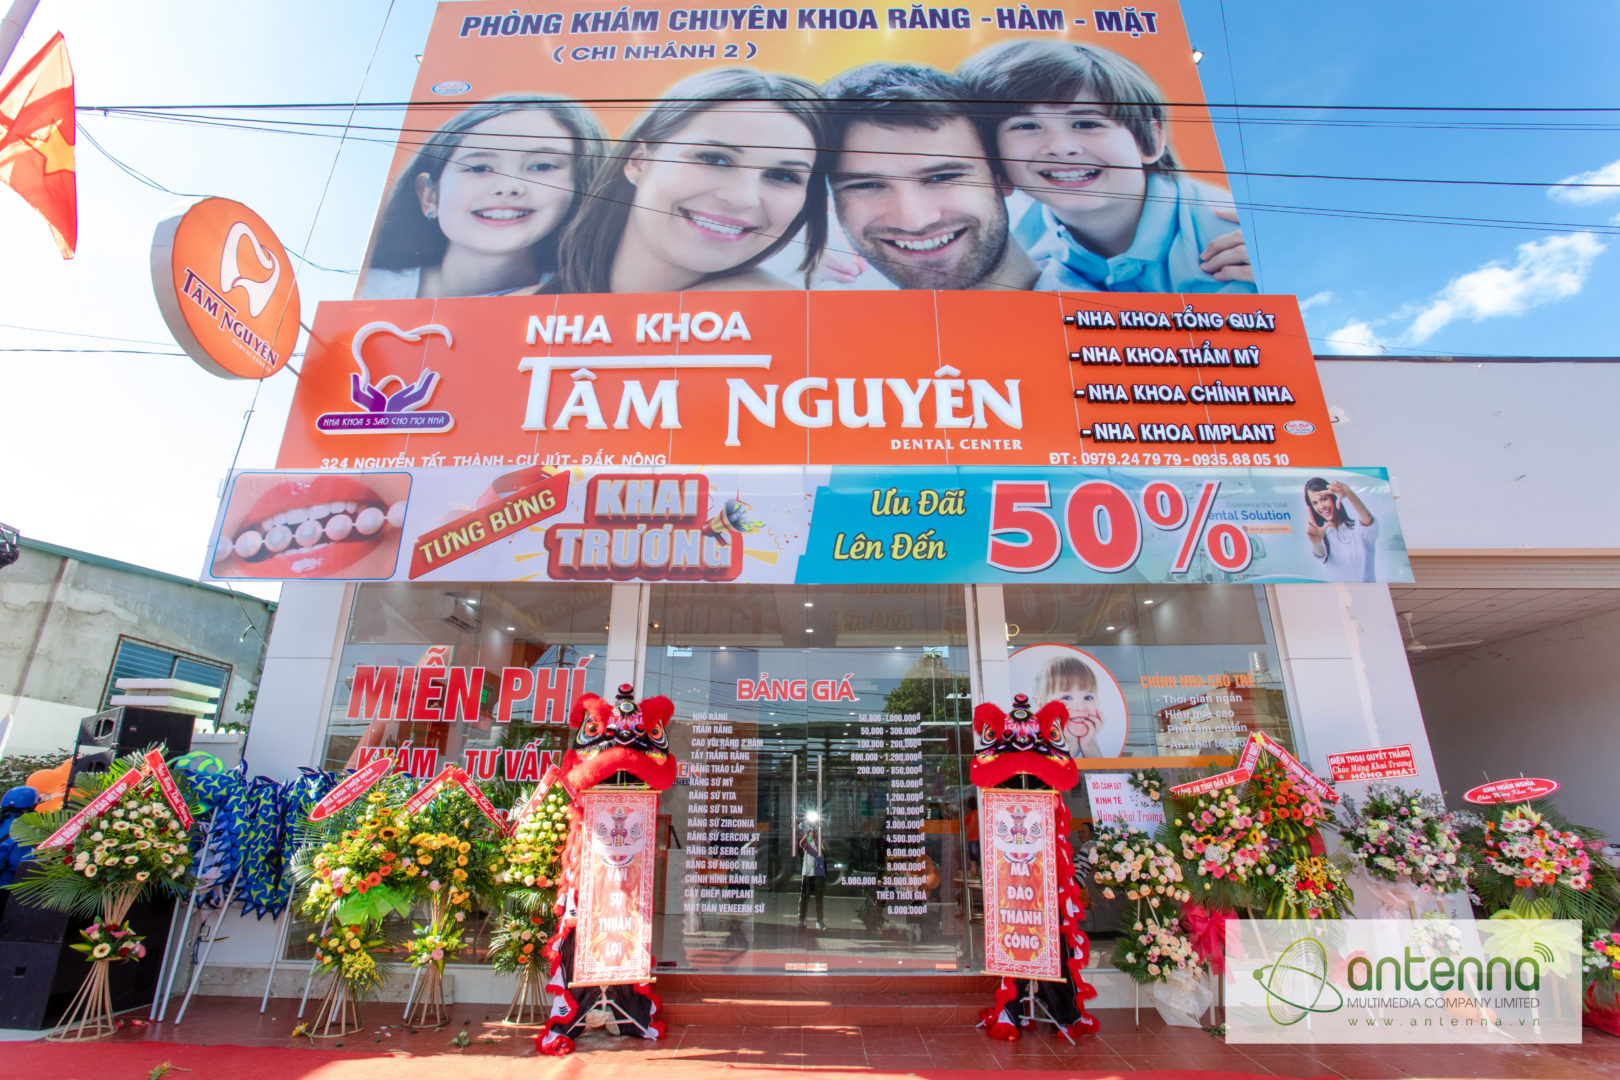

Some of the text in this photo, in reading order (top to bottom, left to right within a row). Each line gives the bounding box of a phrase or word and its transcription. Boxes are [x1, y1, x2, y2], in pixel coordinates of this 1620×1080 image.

[460, 10, 563, 37] PHÒNG
[571, 7, 660, 34] KHÁM
[668, 5, 787, 32] CHUYÊN
[798, 8, 878, 30] KHOA
[887, 4, 971, 31] RĂNG
[1093, 6, 1158, 38] MẶT
[624, 41, 715, 60] NHÁNH
[181, 267, 279, 368] TÂM NGUYÊN
[1119, 311, 1172, 330] KHOA
[1173, 304, 1224, 331] TỔNG
[1227, 309, 1276, 331] QUÁT
[525, 311, 752, 345] NHA KHOA
[1125, 347, 1179, 366] KHOA
[1180, 340, 1231, 367] THẨM
[1233, 345, 1260, 367] MỸ
[517, 354, 1023, 447] TÂM NGUYÊN
[1131, 384, 1188, 404] KHOA
[1189, 380, 1250, 405] CHỈNH
[1253, 386, 1295, 404] NHA
[428, 416, 445, 424] NHÀ
[1140, 424, 1195, 443] KHOA
[1197, 424, 1276, 443] IMPLANT
[891, 439, 1023, 450] DENTAL CENTER
[320, 458, 348, 469] 324
[354, 452, 415, 468] NGUYỄN
[421, 452, 446, 468] TẤT
[453, 453, 503, 465] THÀNH
[516, 453, 539, 465] CƯ
[582, 449, 615, 465] ĐẮK
[622, 452, 666, 465] NÔNG
[1081, 453, 1140, 465] 0979.24
[1143, 453, 1161, 465] 79
[1164, 453, 1182, 465] 79
[1193, 453, 1251, 466] 0935.88
[1253, 454, 1271, 466] 05
[1274, 454, 1289, 466] 10
[594, 479, 699, 517] KHAI
[871, 488, 967, 517] Ưu Đãi
[1209, 510, 1291, 520] ental Solution
[419, 489, 557, 564] TƯNG BỪNG
[987, 478, 1253, 574] 50%
[555, 524, 731, 568] TRƯƠNG
[833, 530, 946, 561] Lên Đến
[346, 647, 595, 724] MIỄN PHÍ
[737, 672, 856, 701] BẢNG GIÁ
[1140, 672, 1176, 688] CHỈNH
[1179, 675, 1205, 688] NHA
[1207, 675, 1230, 687] CHO
[1190, 695, 1212, 705] gian
[464, 747, 503, 780] TƯ
[505, 739, 561, 782] VẤN
[1333, 765, 1349, 774] Chúc
[1371, 762, 1386, 770] Khai
[690, 777, 708, 786] RĂNG
[689, 790, 708, 800] RĂNG
[722, 792, 736, 800] VITA
[1114, 794, 1122, 804] TẾ
[688, 804, 708, 813] RĂNG
[722, 805, 727, 813] TI
[730, 805, 743, 813] TAN
[688, 817, 707, 827] RĂNG
[721, 819, 754, 827] ZIRCONIA
[687, 831, 706, 840] RĂNG
[721, 833, 749, 841] SERCON
[686, 845, 706, 854] RĂNG
[1004, 933, 1040, 950] CÔNG
